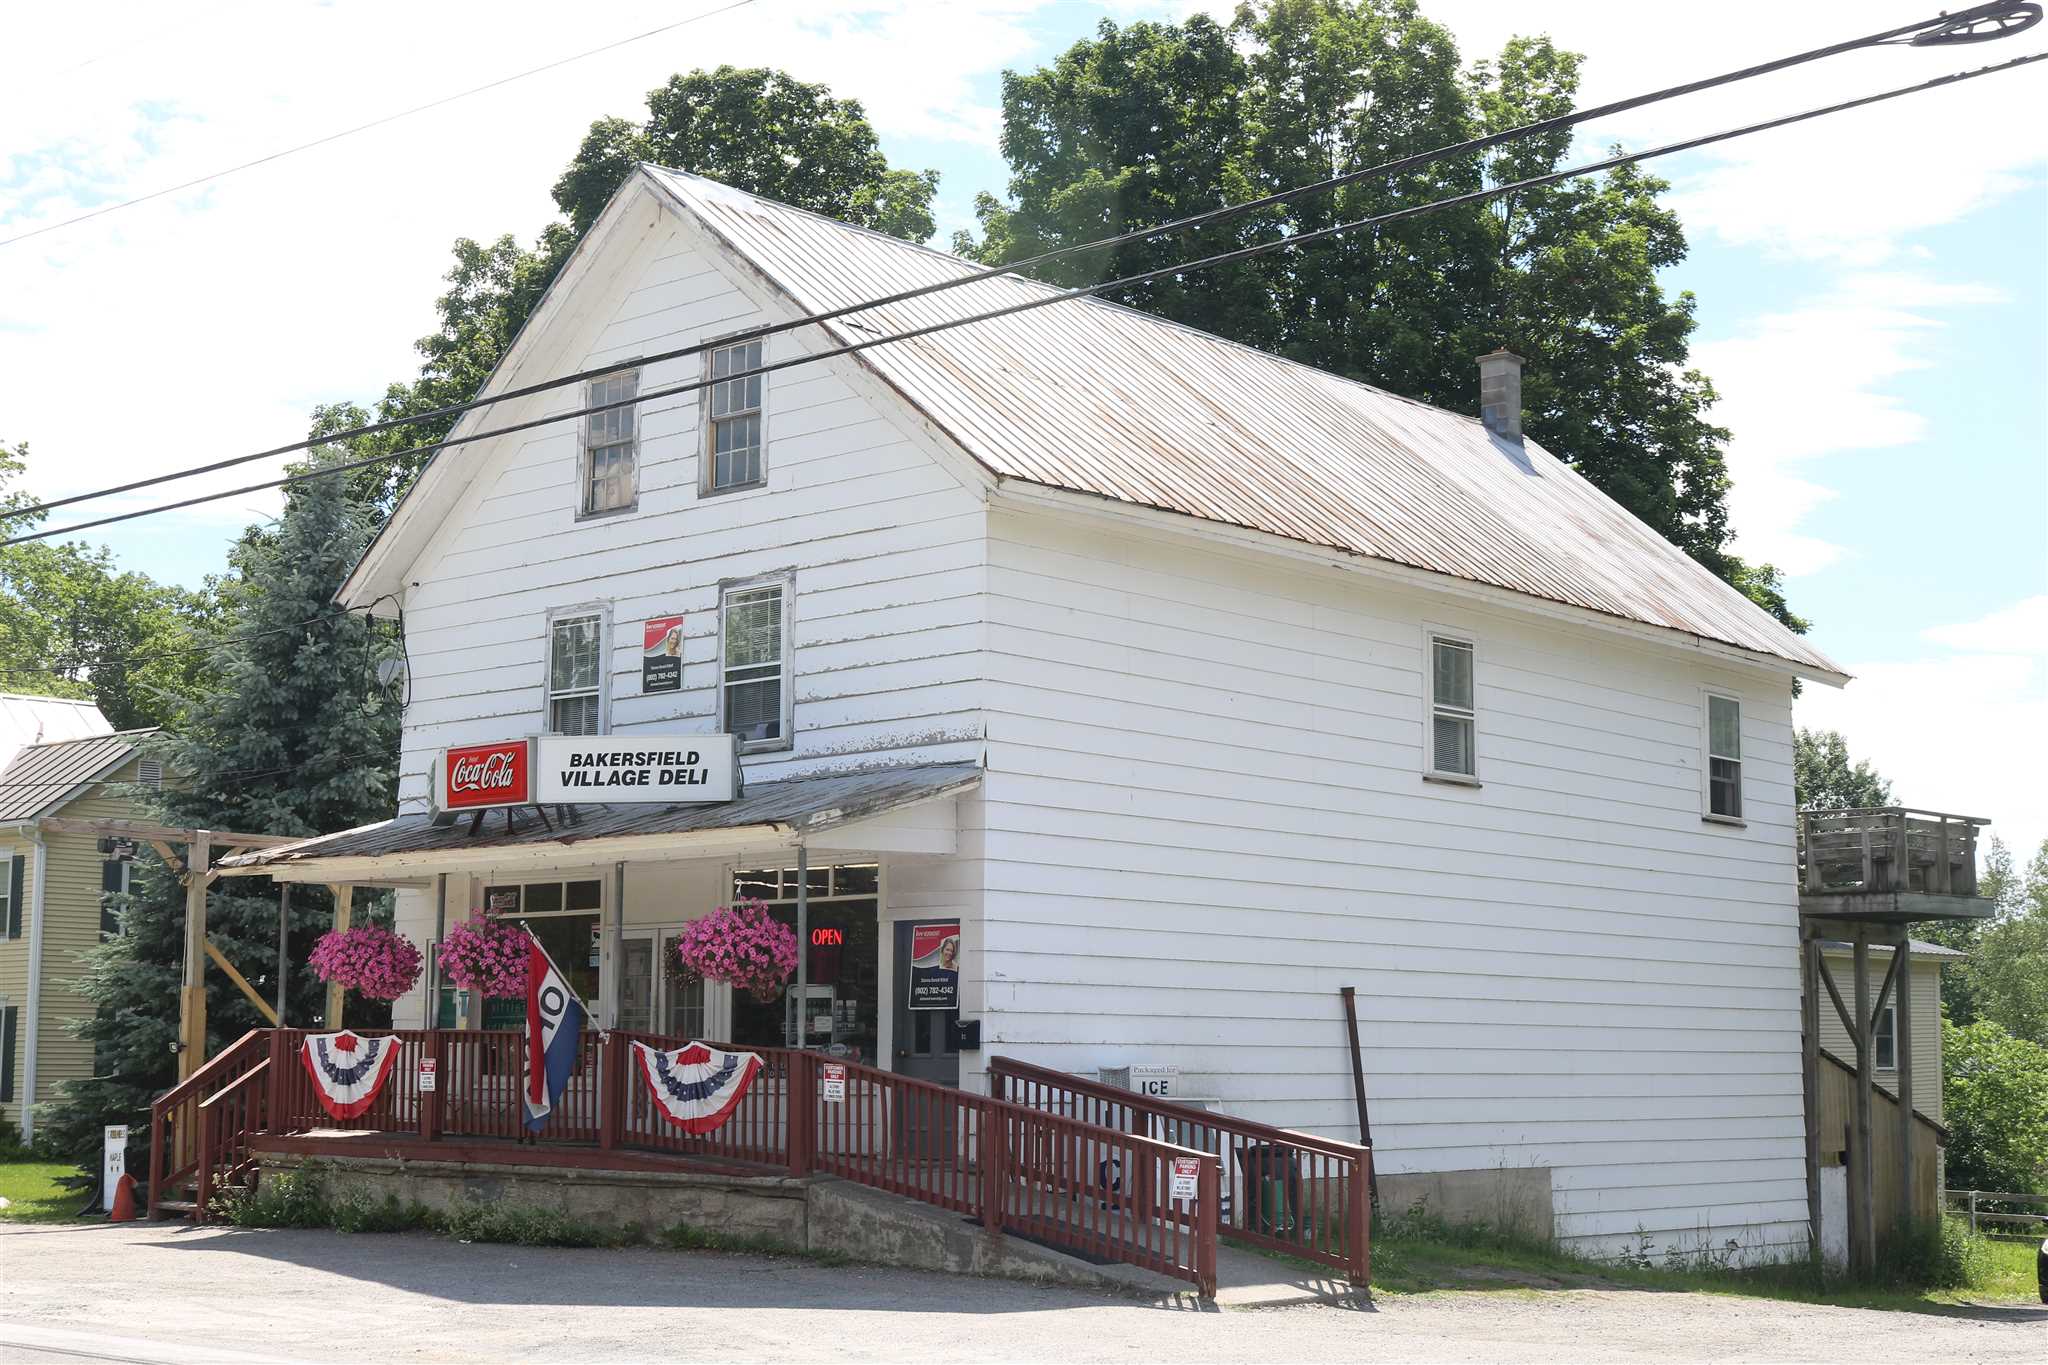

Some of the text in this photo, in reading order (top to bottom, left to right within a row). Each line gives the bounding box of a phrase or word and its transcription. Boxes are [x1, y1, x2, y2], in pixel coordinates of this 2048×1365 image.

[569, 751, 700, 767] BAKERSFIELD
[452, 751, 516, 792] Coca-Cola
[561, 768, 708, 787] VILLAGE DELI
[812, 928, 843, 945] OPEN
[1141, 1080, 1169, 1095] ICE
